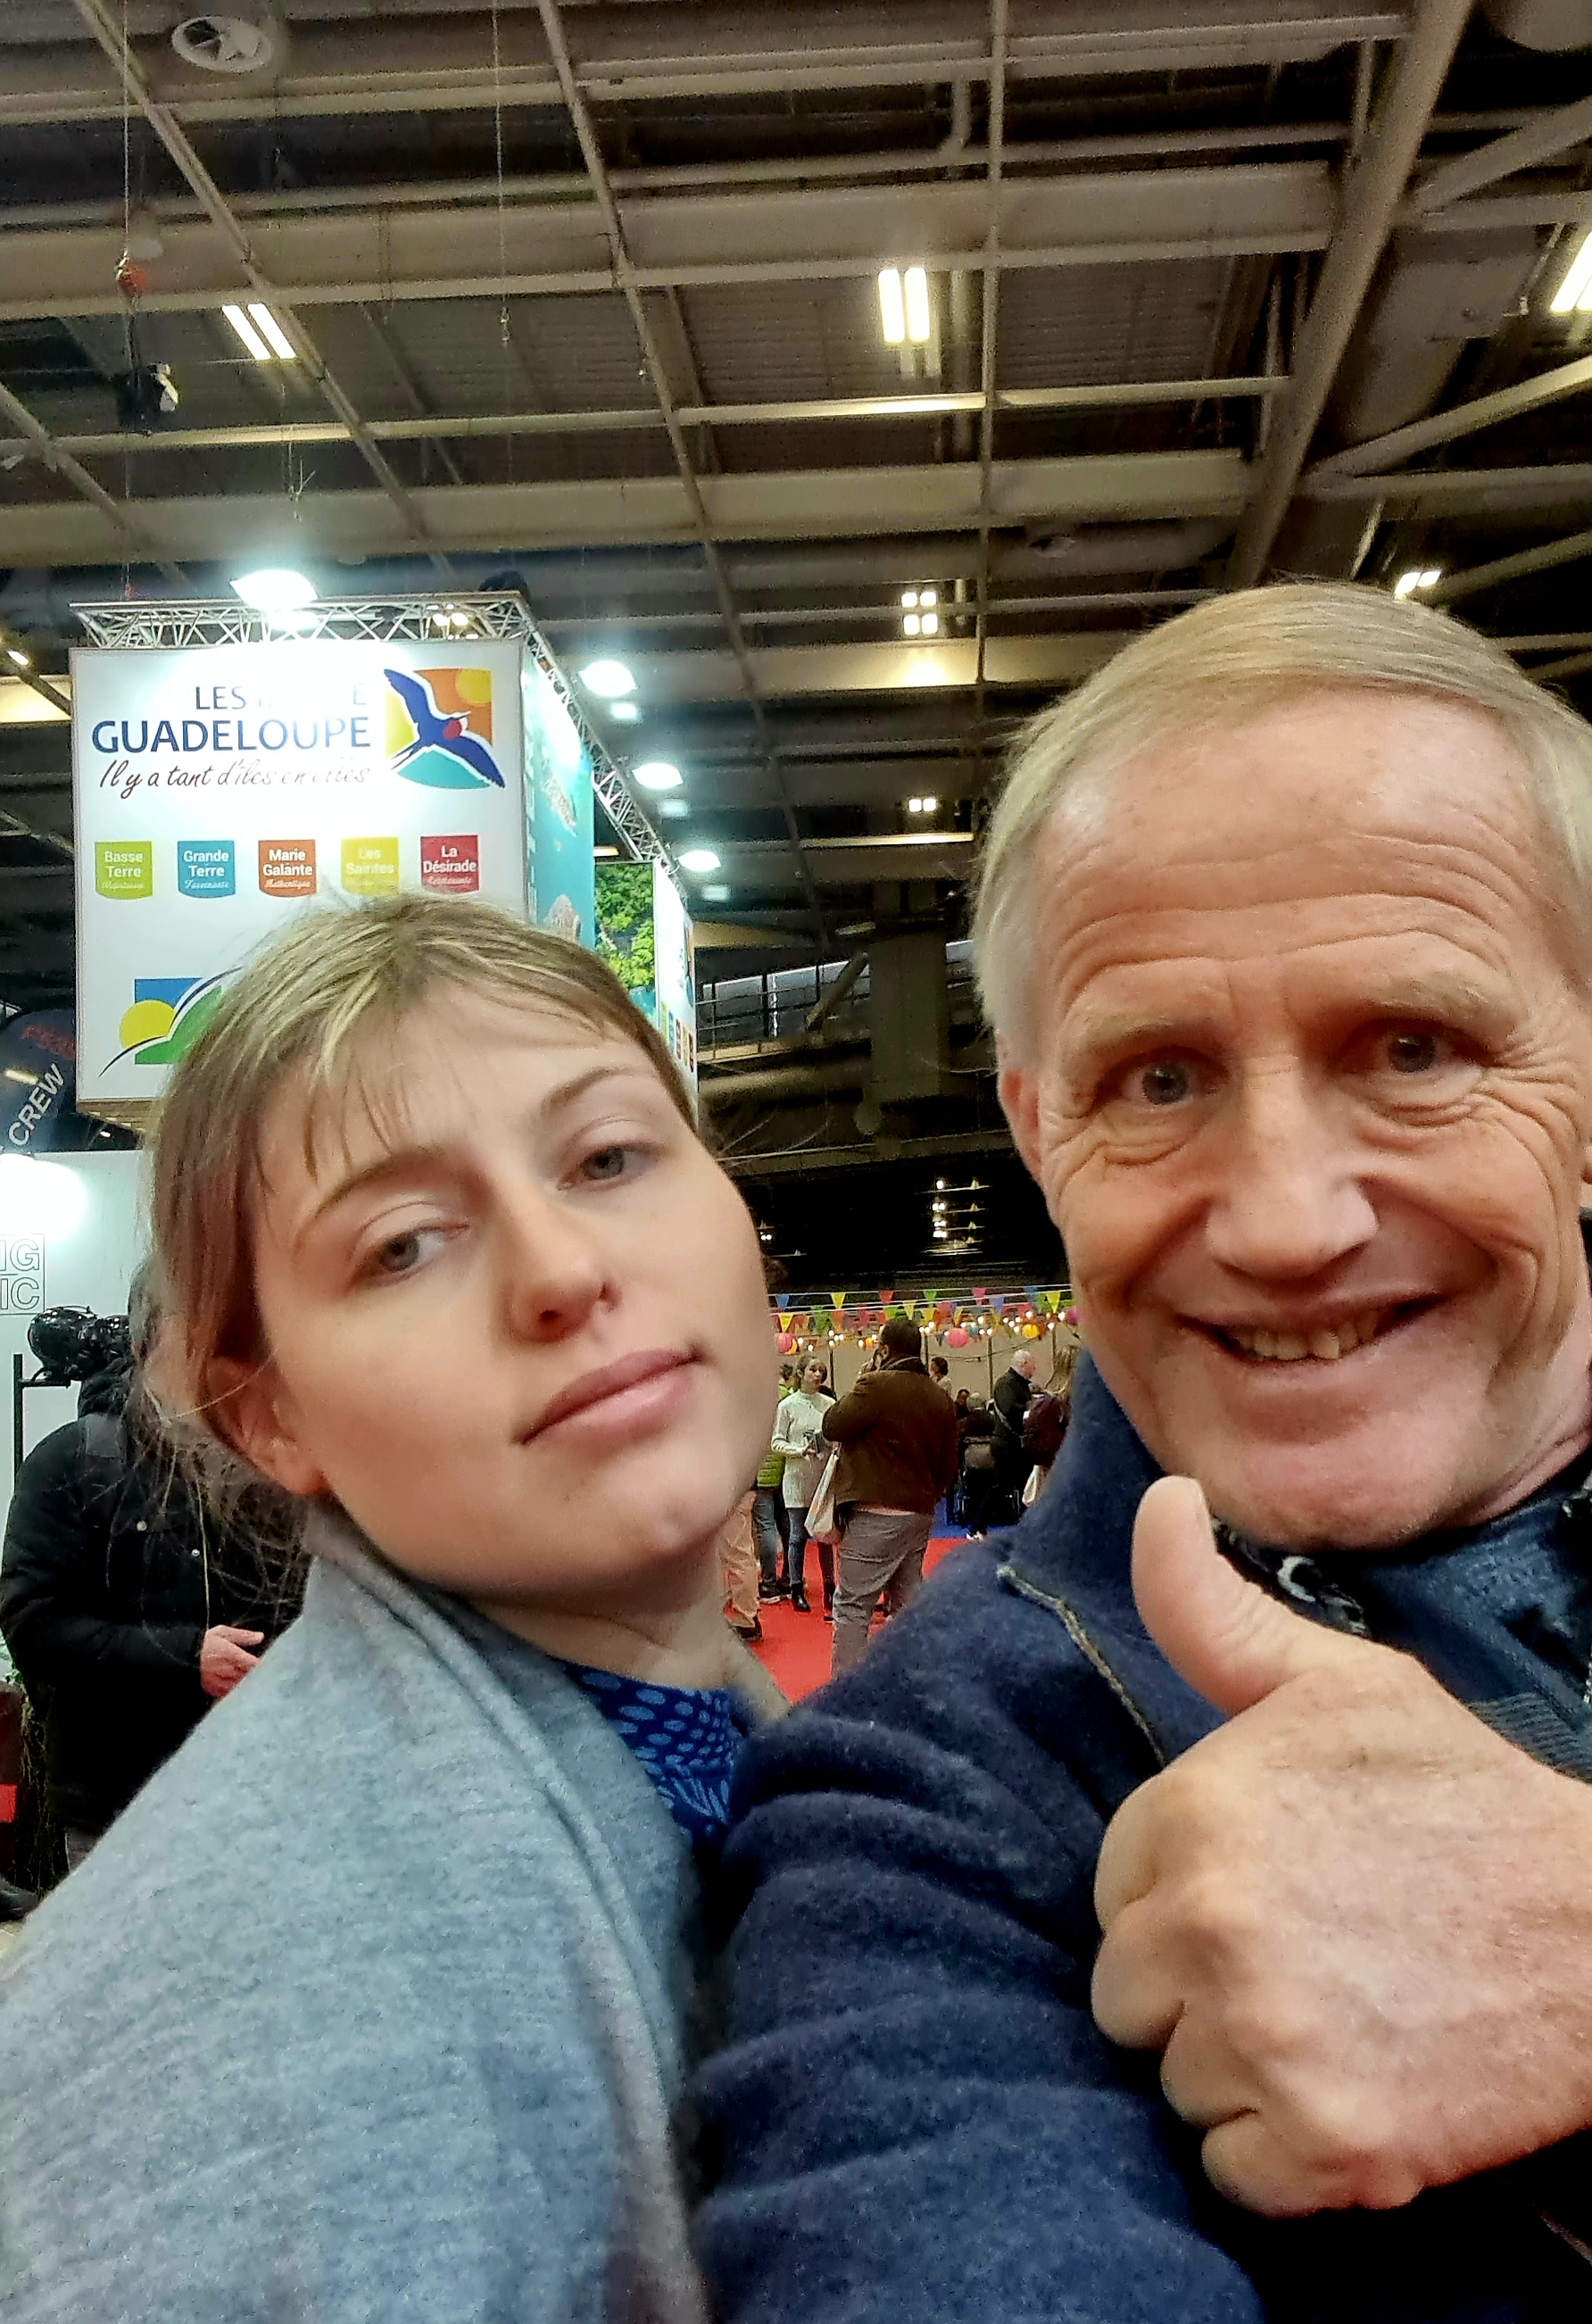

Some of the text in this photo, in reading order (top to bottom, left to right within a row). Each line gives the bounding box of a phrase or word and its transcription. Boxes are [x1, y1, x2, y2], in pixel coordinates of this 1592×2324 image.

[195, 685, 246, 710] LES
[91, 716, 371, 754] GUADELOUPE
[99, 759, 129, 788] Il
[120, 772, 143, 800] y
[147, 771, 161, 787] a
[167, 765, 215, 788] tant
[104, 851, 144, 863] Basse
[183, 849, 230, 863] Grande
[269, 848, 306, 862] Marie
[440, 845, 458, 858] La
[104, 865, 143, 878] Terre
[187, 864, 226, 877] Terre
[262, 863, 313, 876] Galante
[422, 859, 477, 874] Désirade
[8, 1062, 64, 1147] CREW
